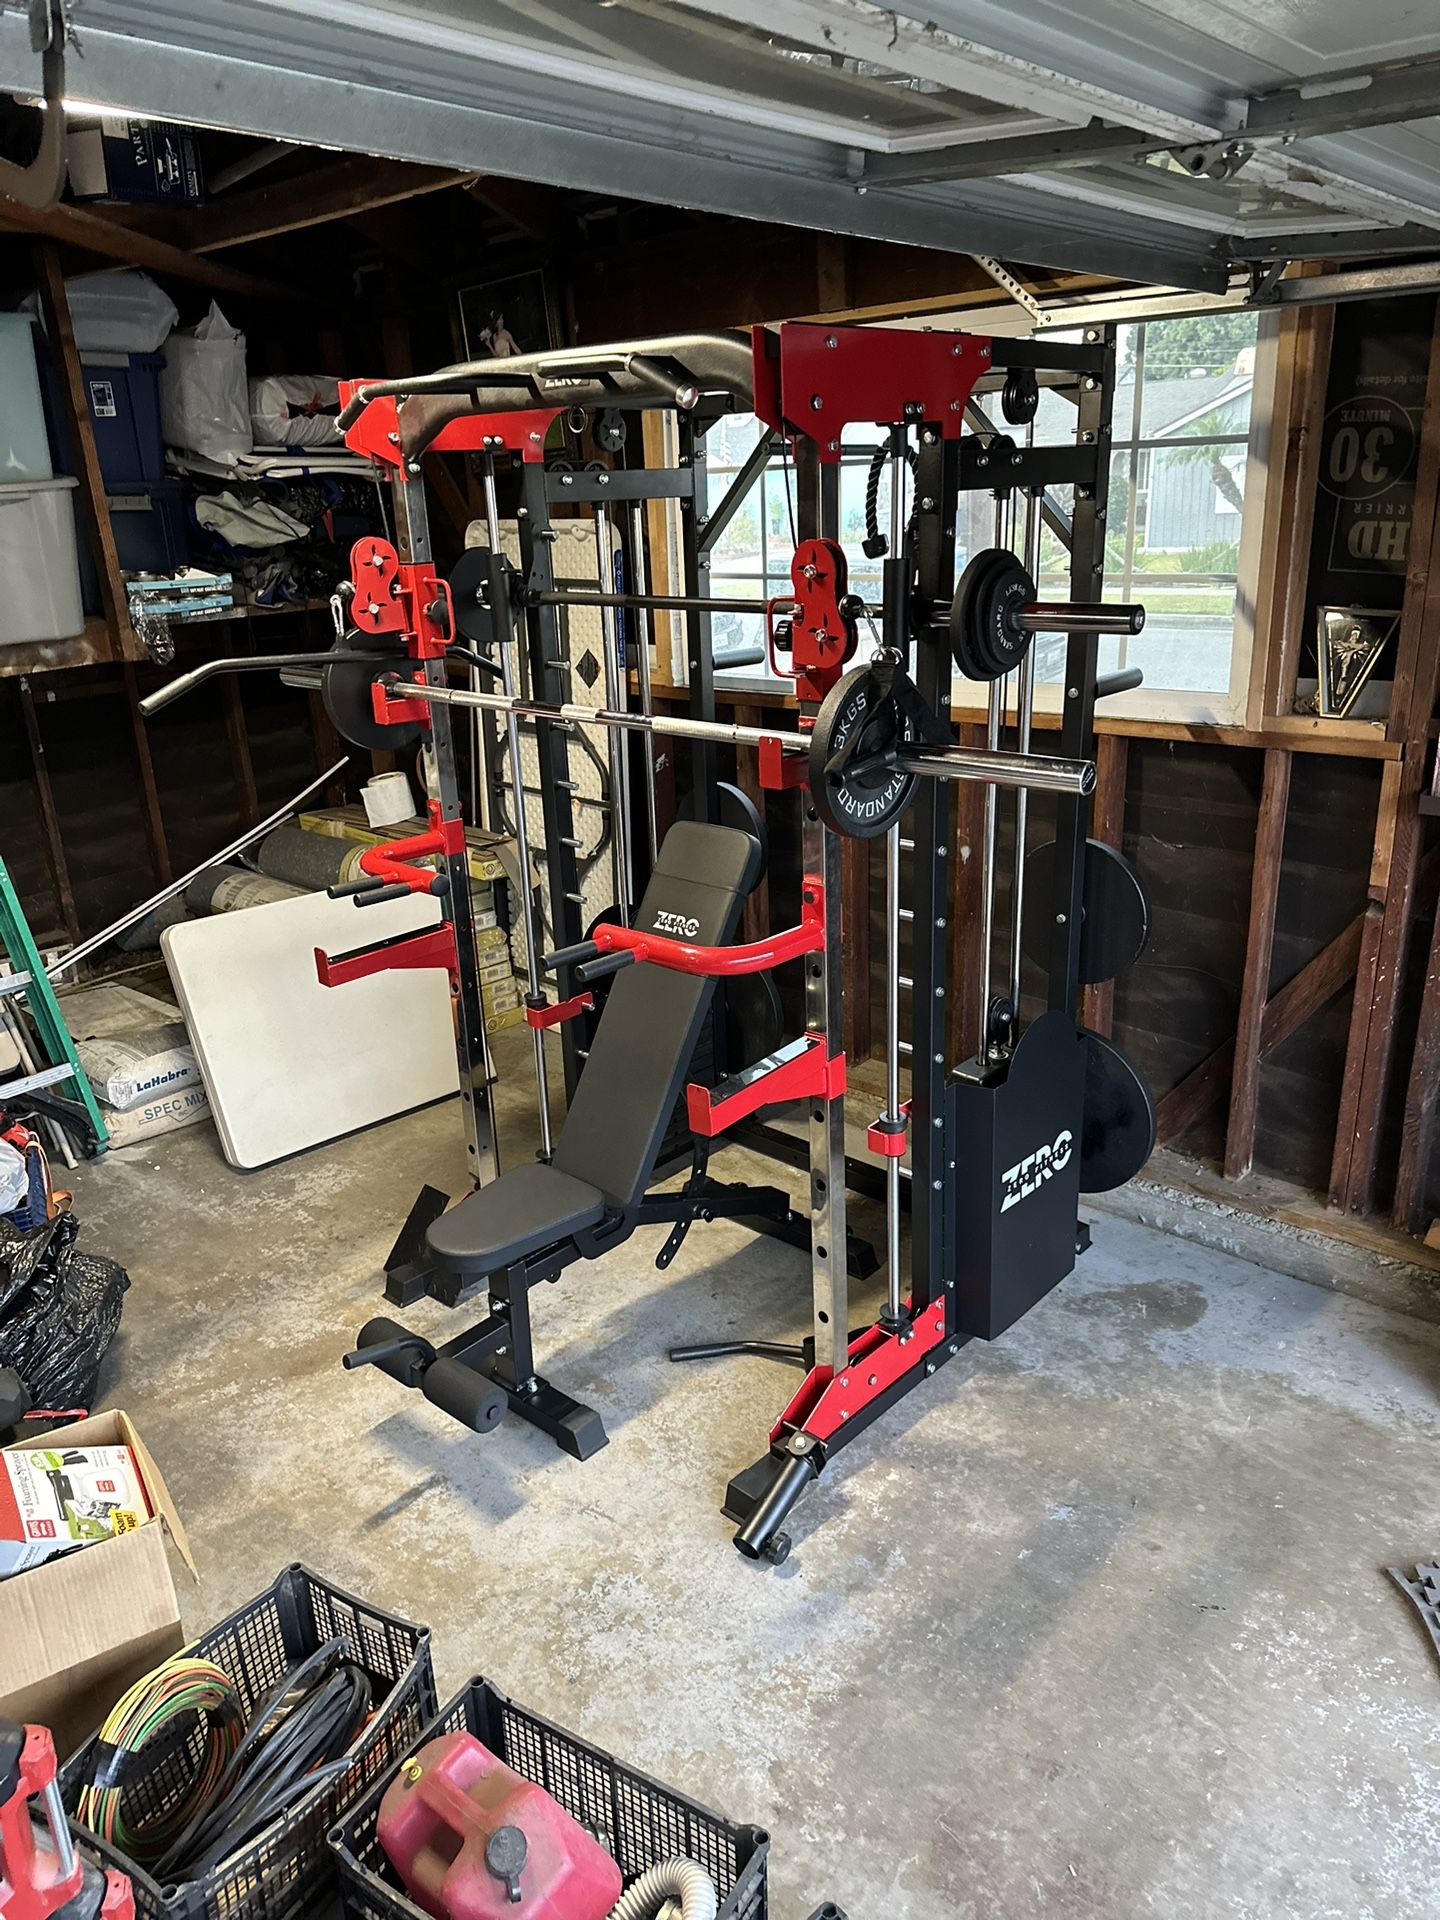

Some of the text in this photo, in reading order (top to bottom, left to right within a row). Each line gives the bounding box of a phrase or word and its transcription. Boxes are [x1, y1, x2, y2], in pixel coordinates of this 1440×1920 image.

[1341, 409, 1391, 422] MINUTE
[1329, 427, 1394, 483] 30
[1353, 503, 1413, 515] RRIER
[1347, 520, 1410, 561] HD
[837, 773, 905, 818] STANDARD
[652, 910, 700, 937] ZERO
[136, 1067, 189, 1092] LaHabra
[144, 1091, 208, 1120] SPEC MIX
[1000, 1129, 1073, 1213] ZERO
[12, 1452, 27, 1476] Sprayer
[18, 1476, 34, 1506] Foaming
[115, 1512, 126, 1535] Foam
